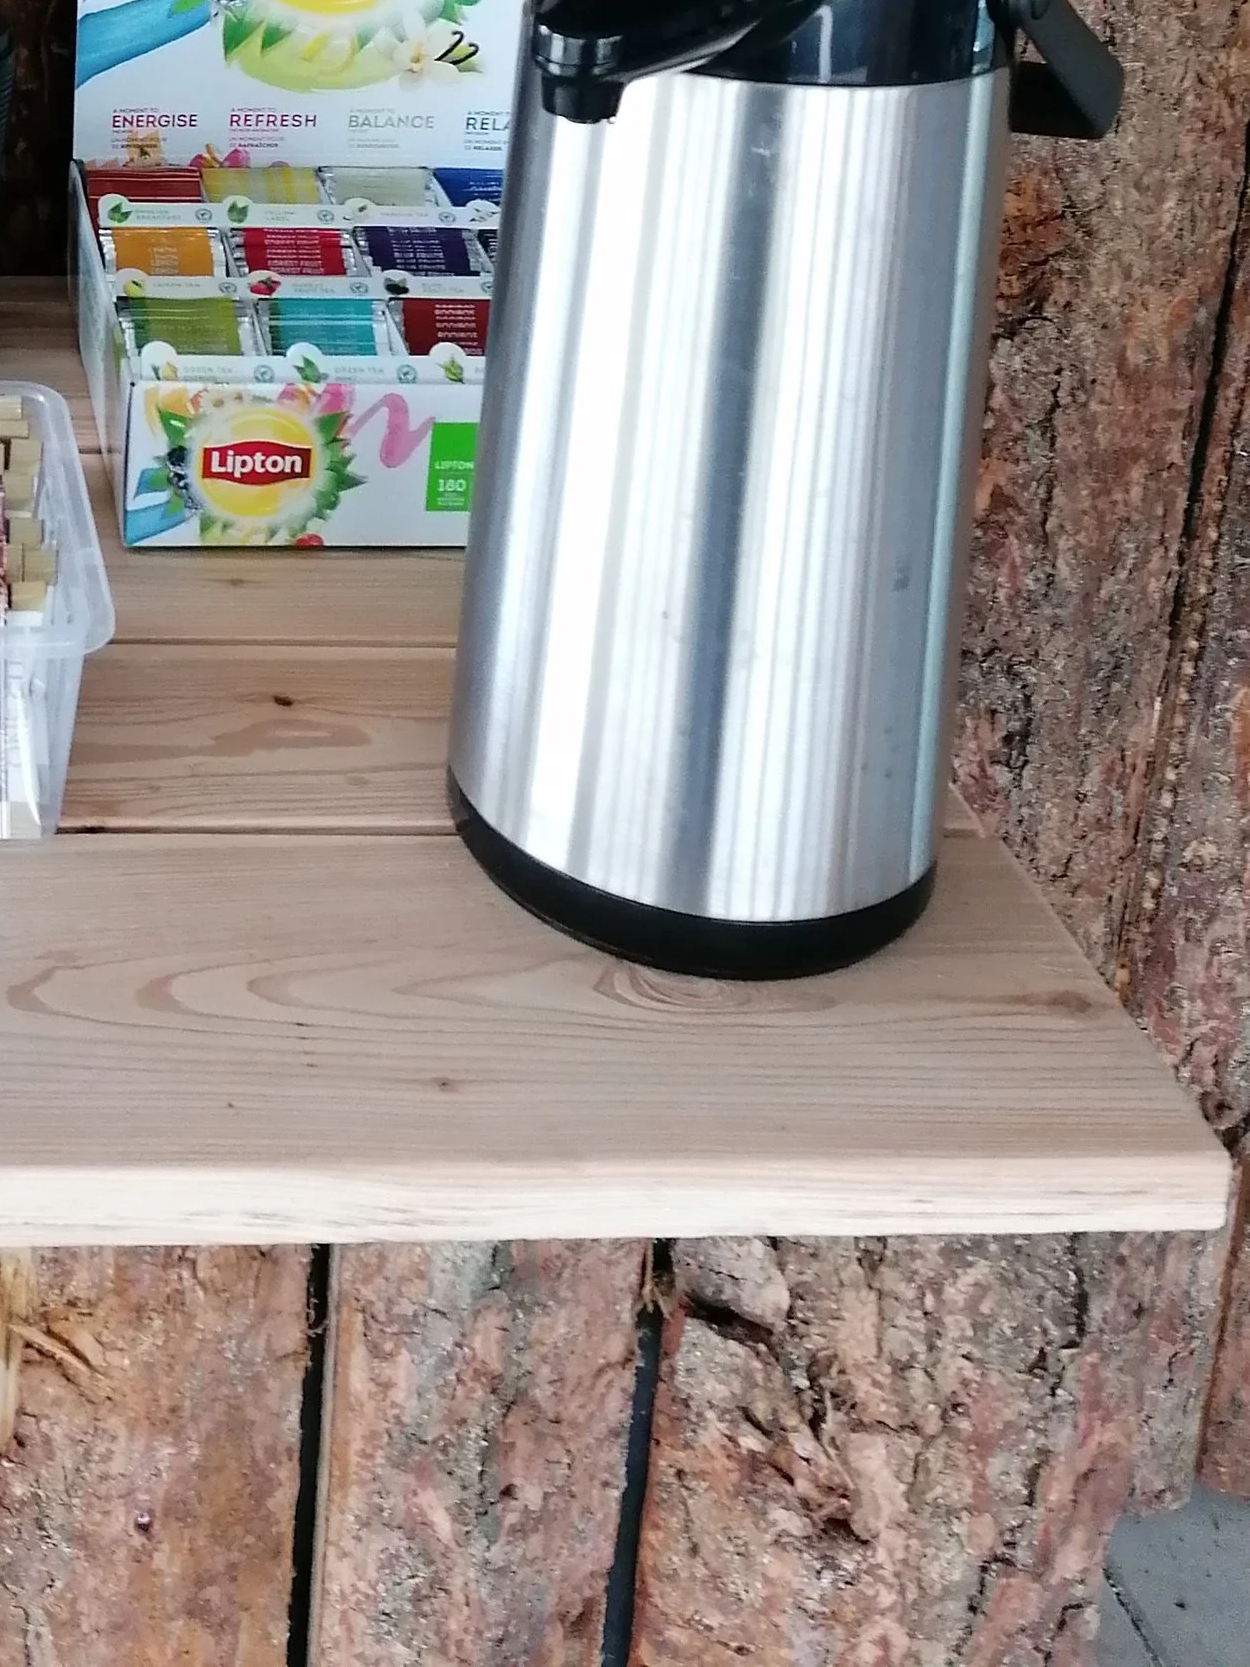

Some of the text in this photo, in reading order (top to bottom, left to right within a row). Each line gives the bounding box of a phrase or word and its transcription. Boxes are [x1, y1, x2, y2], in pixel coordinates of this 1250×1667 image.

[112, 114, 198, 129] ENERGISE
[229, 114, 317, 128] REFRESH
[348, 115, 435, 129] BALANCE
[210, 448, 302, 479] Lipton
[437, 478, 467, 492] 180
